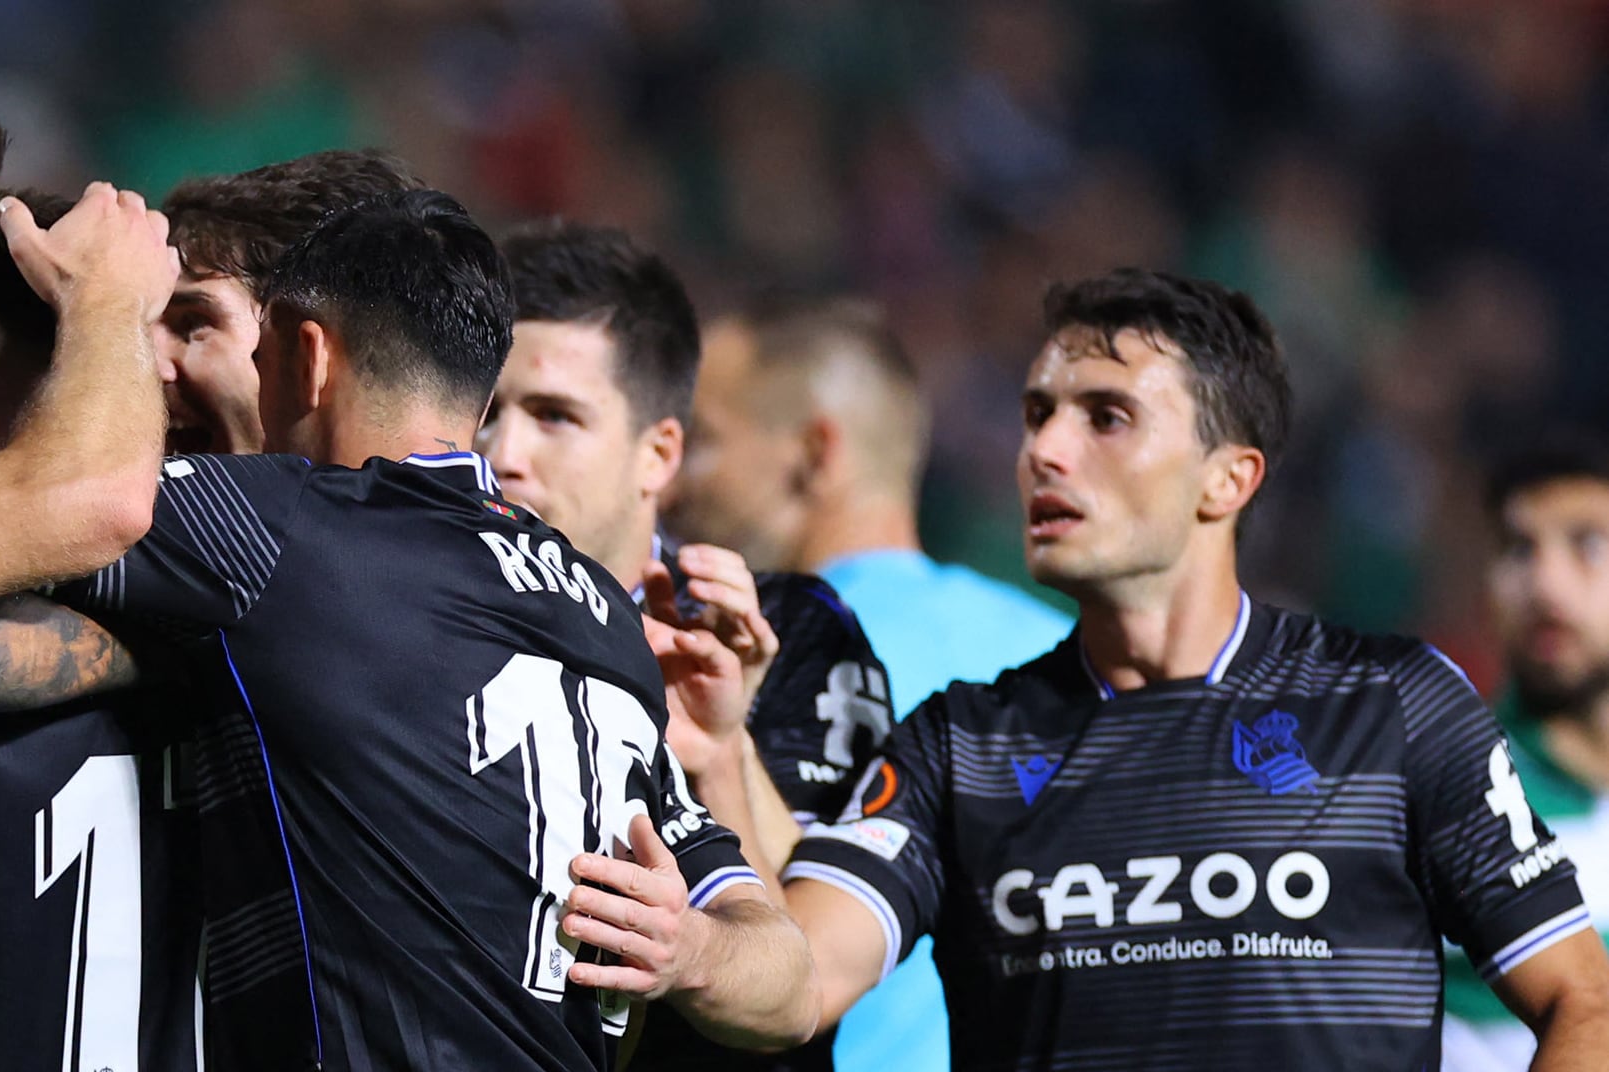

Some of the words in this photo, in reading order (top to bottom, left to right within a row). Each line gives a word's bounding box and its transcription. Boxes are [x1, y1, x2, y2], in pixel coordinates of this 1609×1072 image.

[478, 531, 610, 626] RICO
[992, 851, 1331, 936] CAZOO
[1232, 932, 1334, 960] Disfruta.
